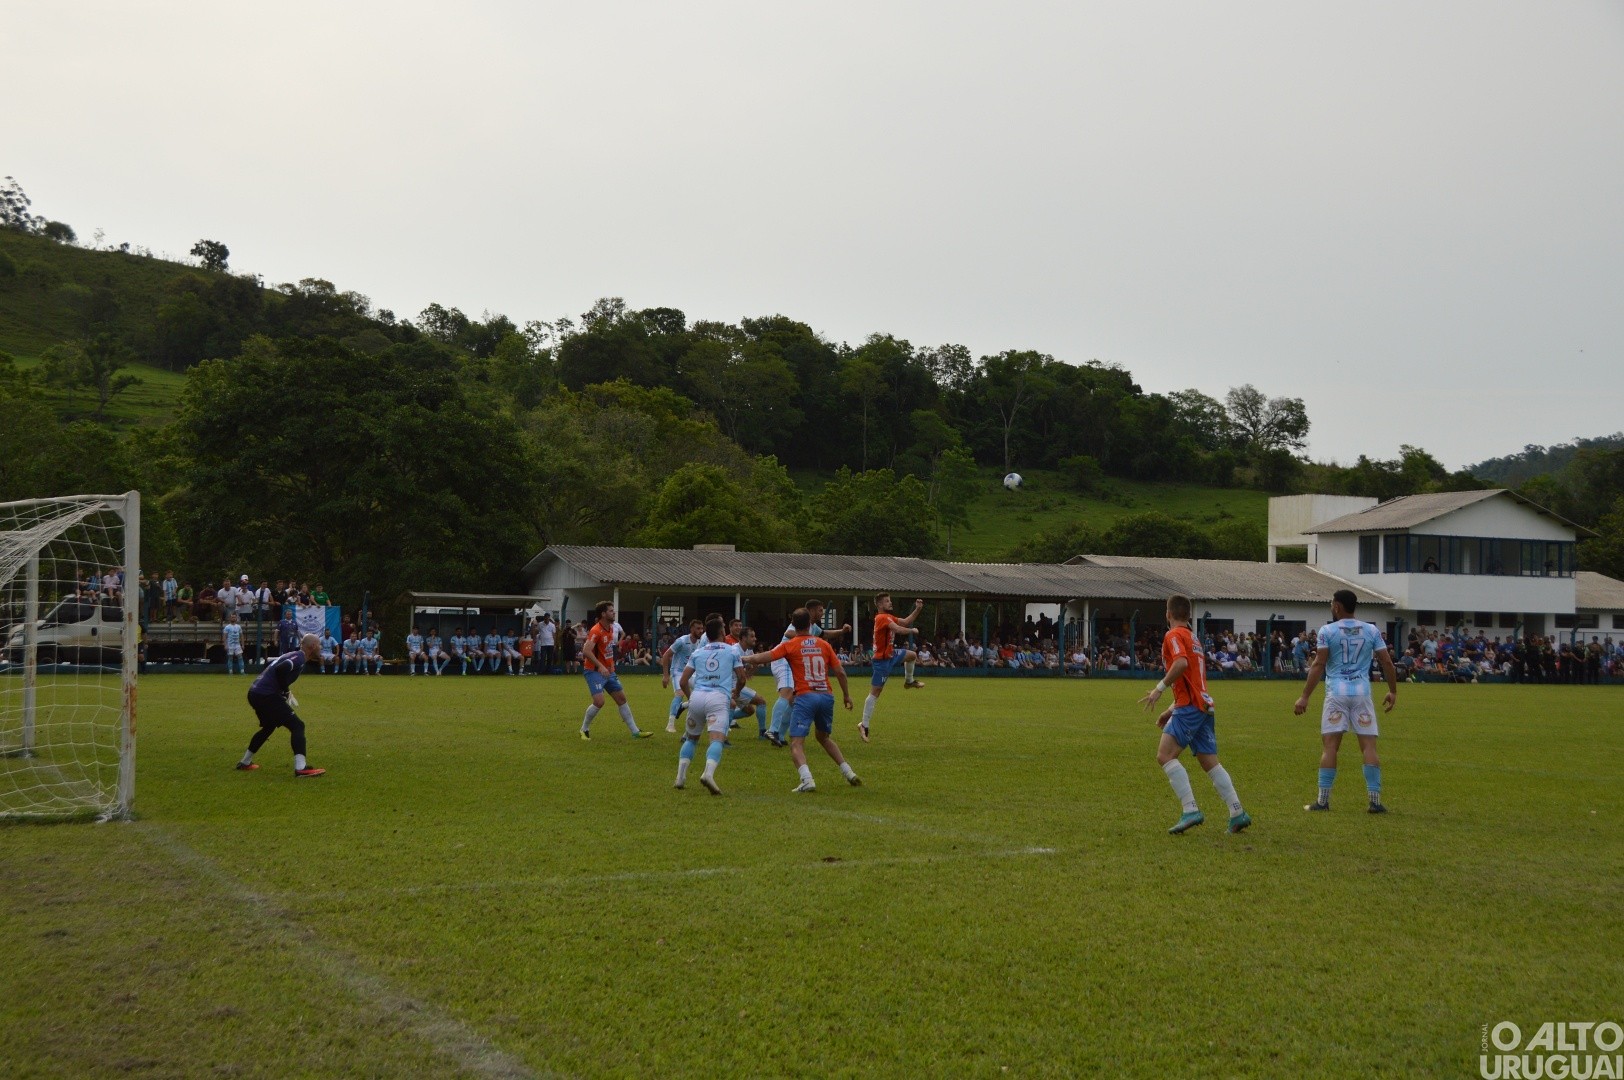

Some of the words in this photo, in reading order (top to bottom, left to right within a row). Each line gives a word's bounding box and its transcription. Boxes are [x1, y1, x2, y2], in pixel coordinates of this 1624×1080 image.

[705, 652, 719, 672] 6
[1340, 638, 1365, 664] 17
[802, 655, 826, 681] 10
